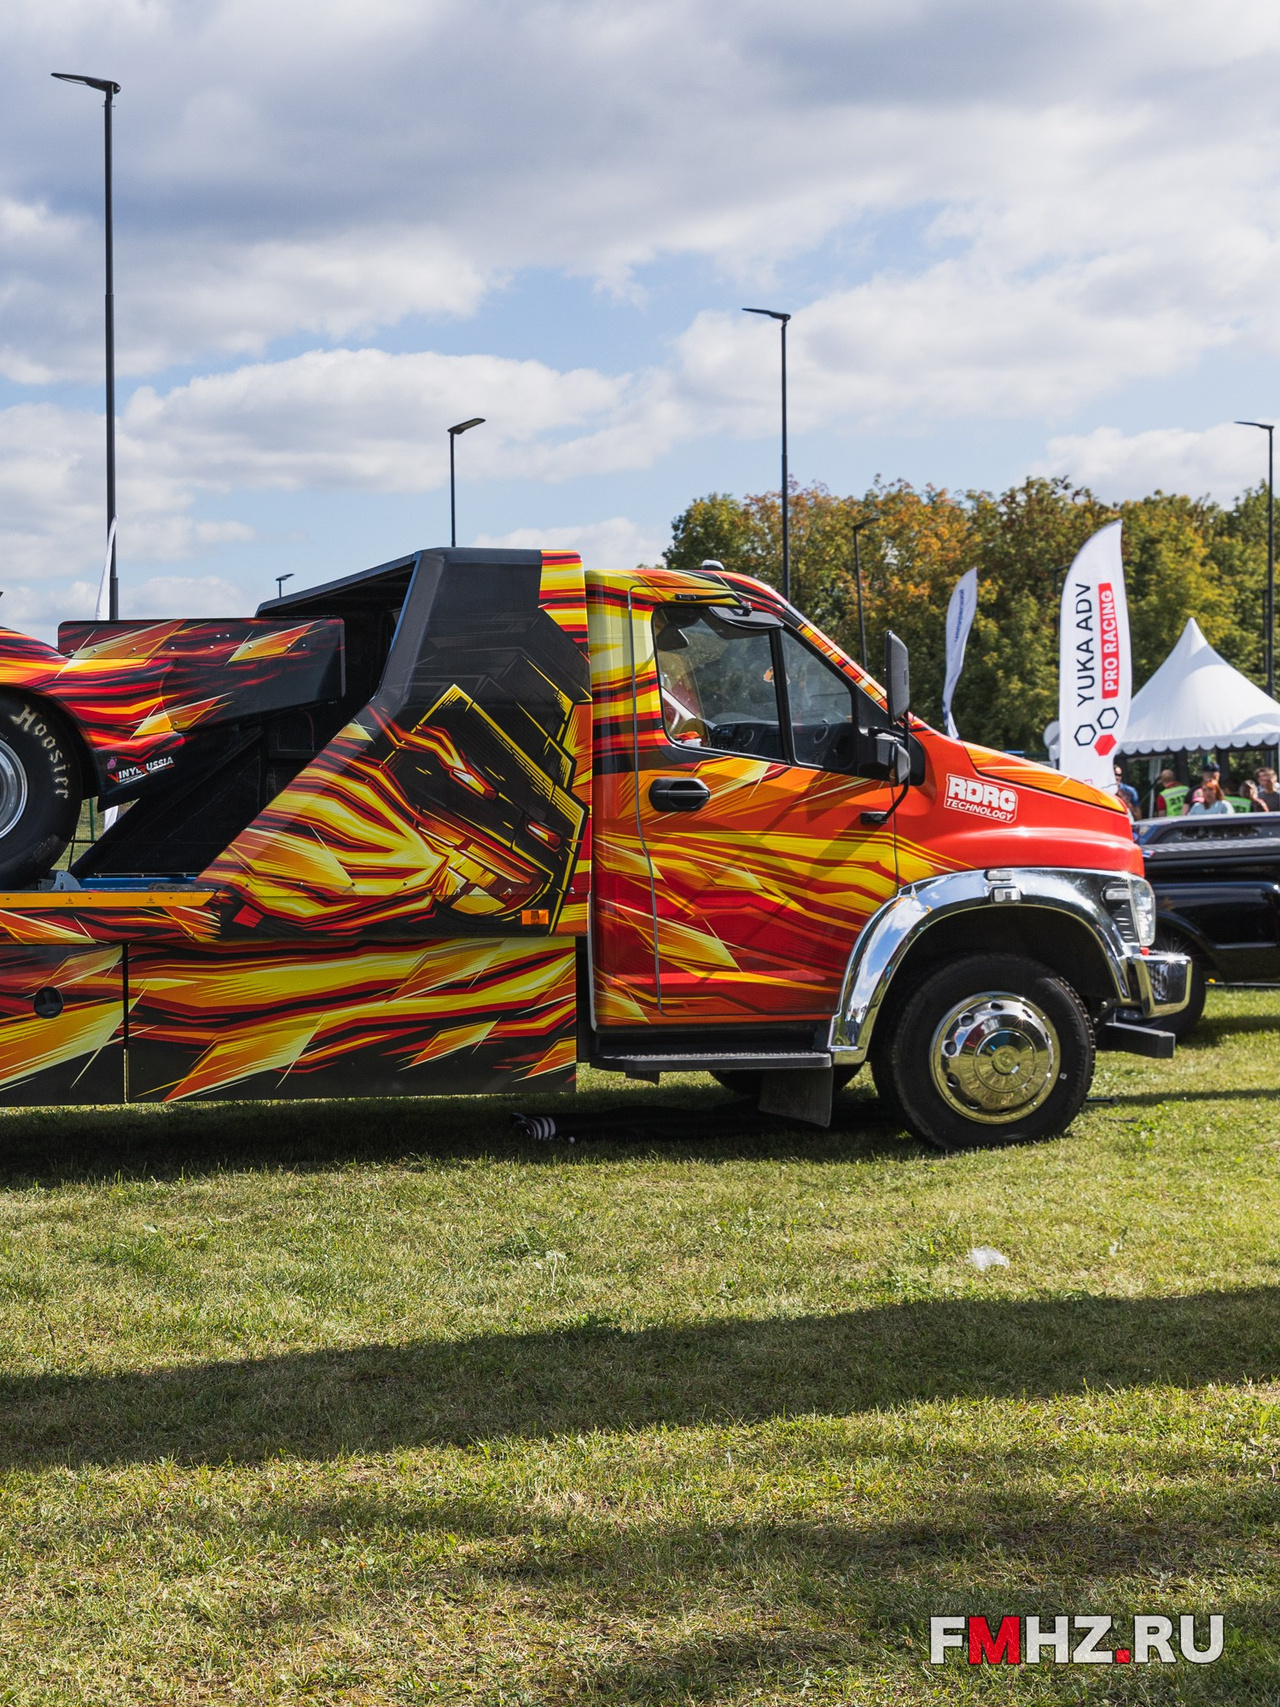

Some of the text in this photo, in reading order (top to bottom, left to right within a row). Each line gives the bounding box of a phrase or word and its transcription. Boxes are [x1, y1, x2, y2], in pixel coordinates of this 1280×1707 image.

[1075, 583, 1095, 708] YUKA ADV
[1101, 589, 1118, 691] PRO RACING
[8, 704, 71, 800] Hoosier
[948, 776, 1016, 812] RDRC
[946, 798, 1014, 821] TECHNOLOGY
